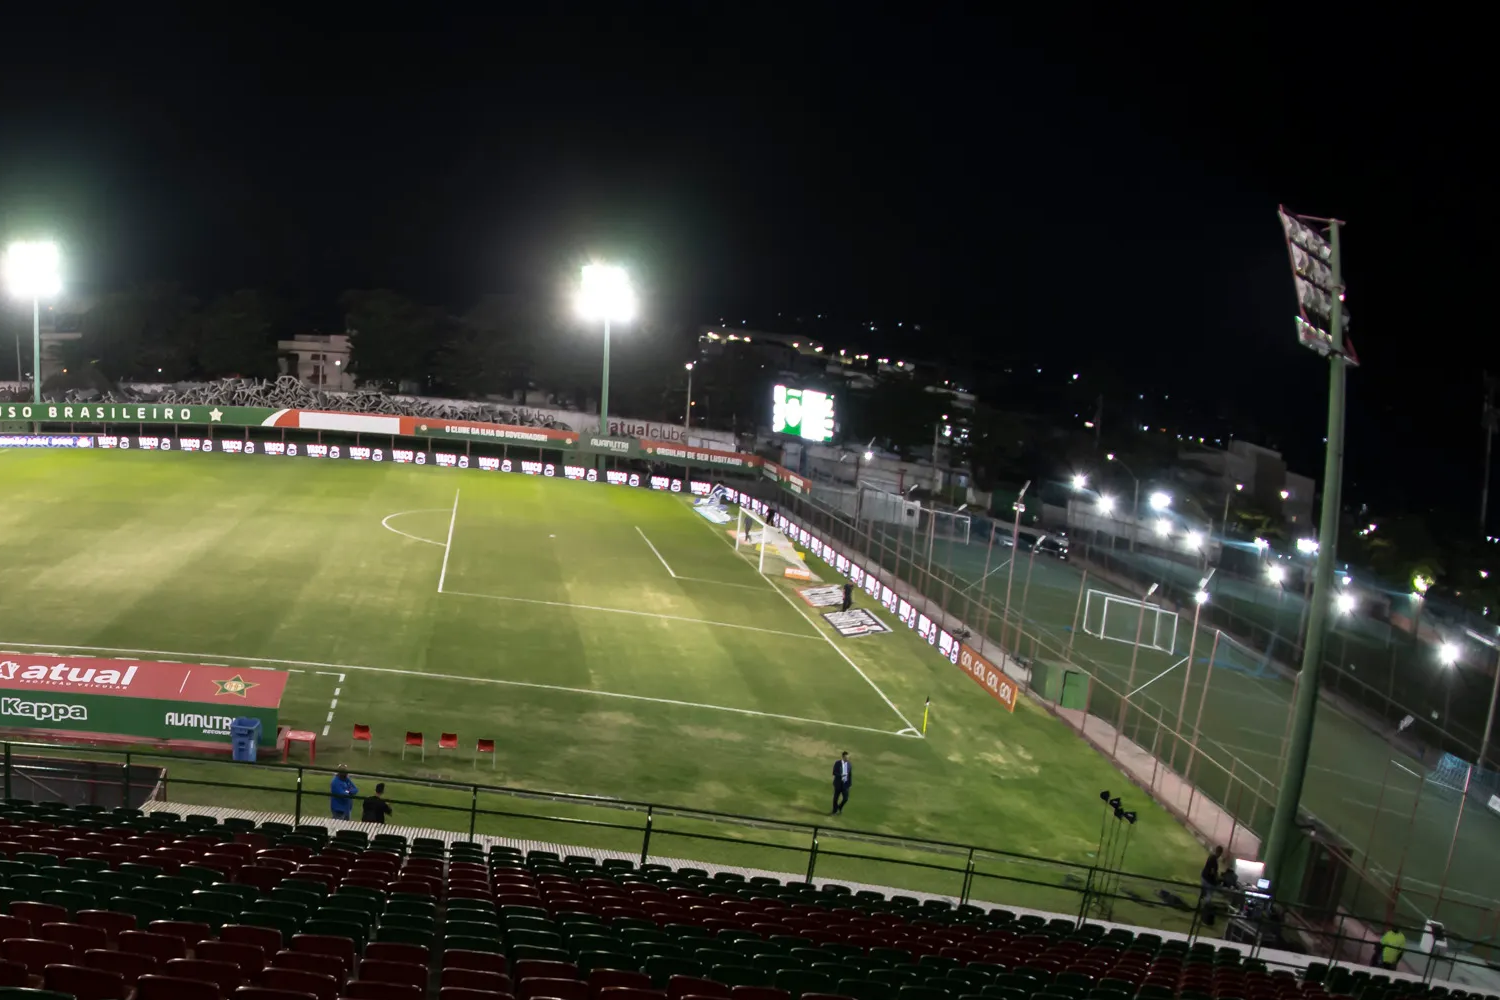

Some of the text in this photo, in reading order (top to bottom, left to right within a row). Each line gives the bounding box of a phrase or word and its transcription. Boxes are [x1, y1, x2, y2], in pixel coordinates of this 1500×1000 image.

[49, 406, 191, 420] BRASILEIRO
[97, 435, 117, 446] VASCO
[138, 436, 158, 447] VASCO
[179, 438, 200, 449] VASCO
[221, 439, 242, 450] VASCO
[263, 441, 284, 452] VASCO
[306, 444, 327, 455] VASCO
[349, 446, 370, 457] VASCO
[392, 449, 413, 460] VASCO
[435, 452, 456, 463] VASCO
[478, 456, 499, 467] VASCO
[521, 460, 542, 471] VASCO
[563, 465, 584, 476] VASCO
[606, 470, 627, 481] VASCO
[689, 480, 710, 491] VASCO
[21, 663, 138, 686] atual
[961, 651, 1011, 704] GOL GOL GOL GOL
[2, 697, 87, 721] Kappa
[165, 711, 236, 730] AVANUTR
